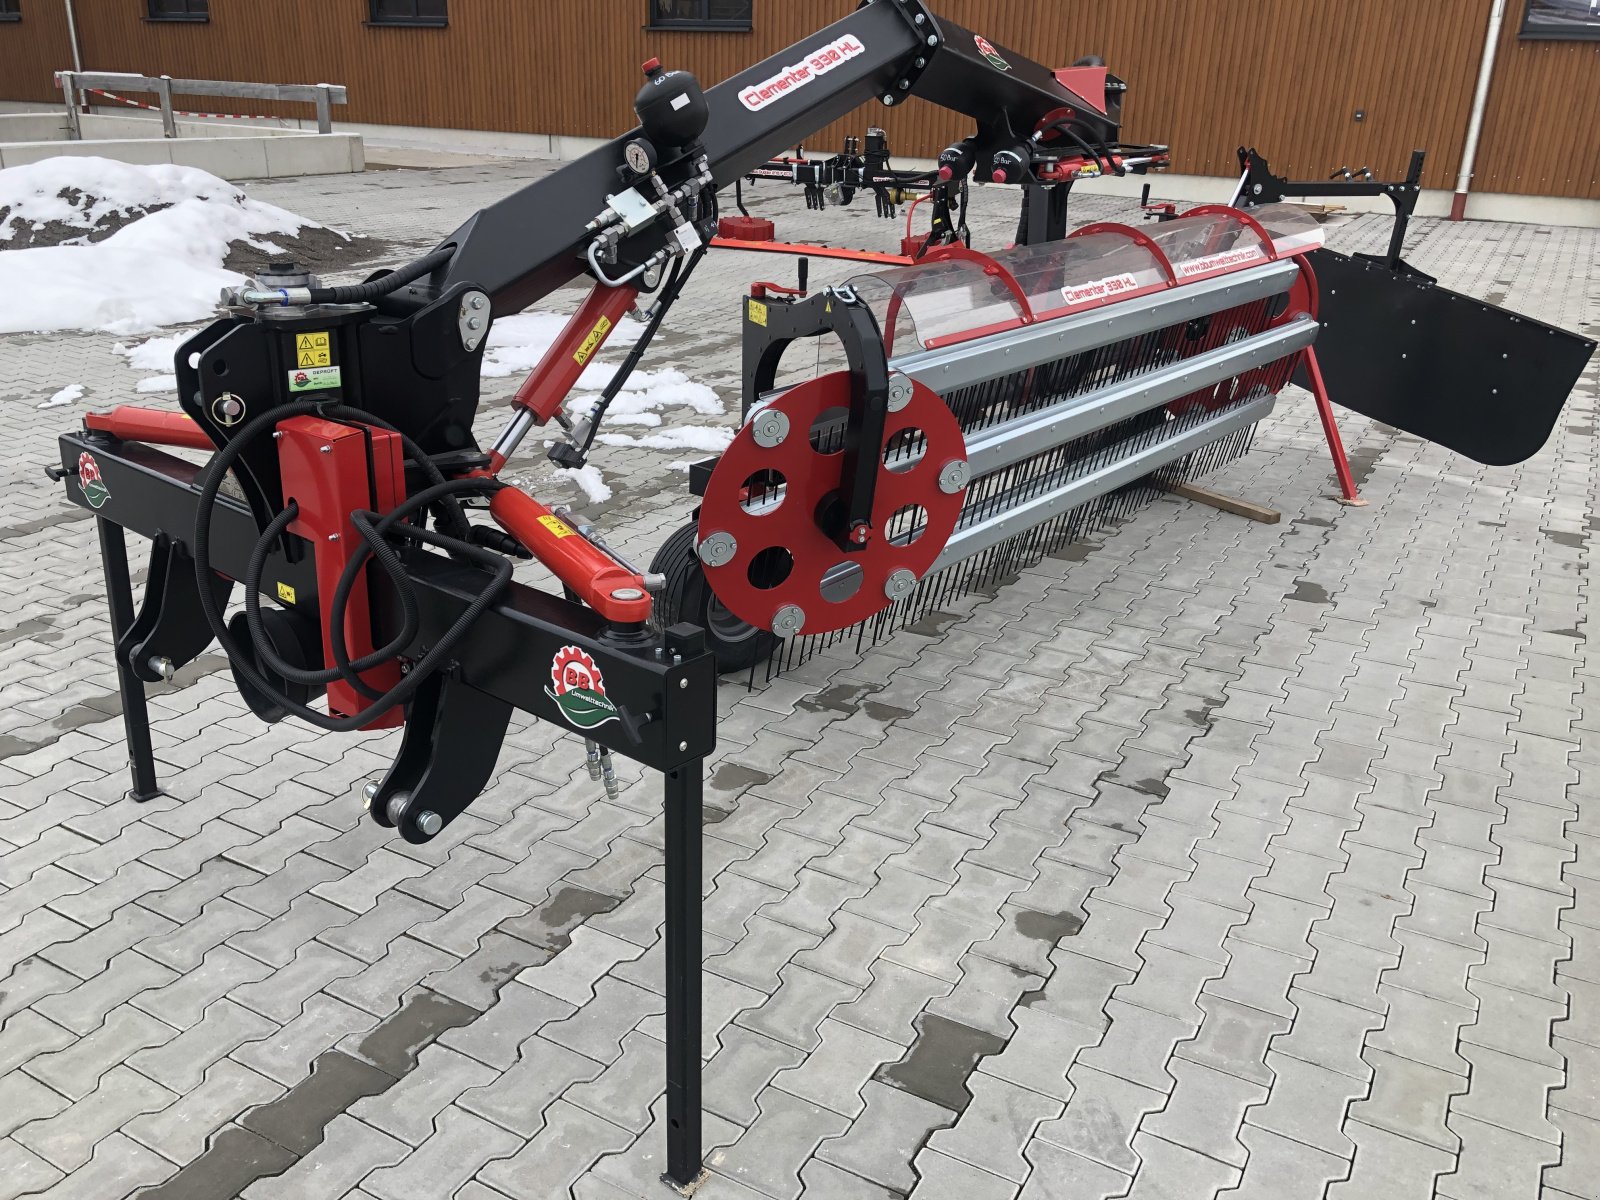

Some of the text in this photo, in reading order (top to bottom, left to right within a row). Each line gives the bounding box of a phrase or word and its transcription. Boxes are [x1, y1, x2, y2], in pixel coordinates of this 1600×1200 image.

[744, 41, 860, 107] Clementer 330 HL
[1064, 277, 1136, 302] Clementer 330 HL
[565, 667, 590, 691] BB
[571, 689, 614, 712] Umwelttechnik
